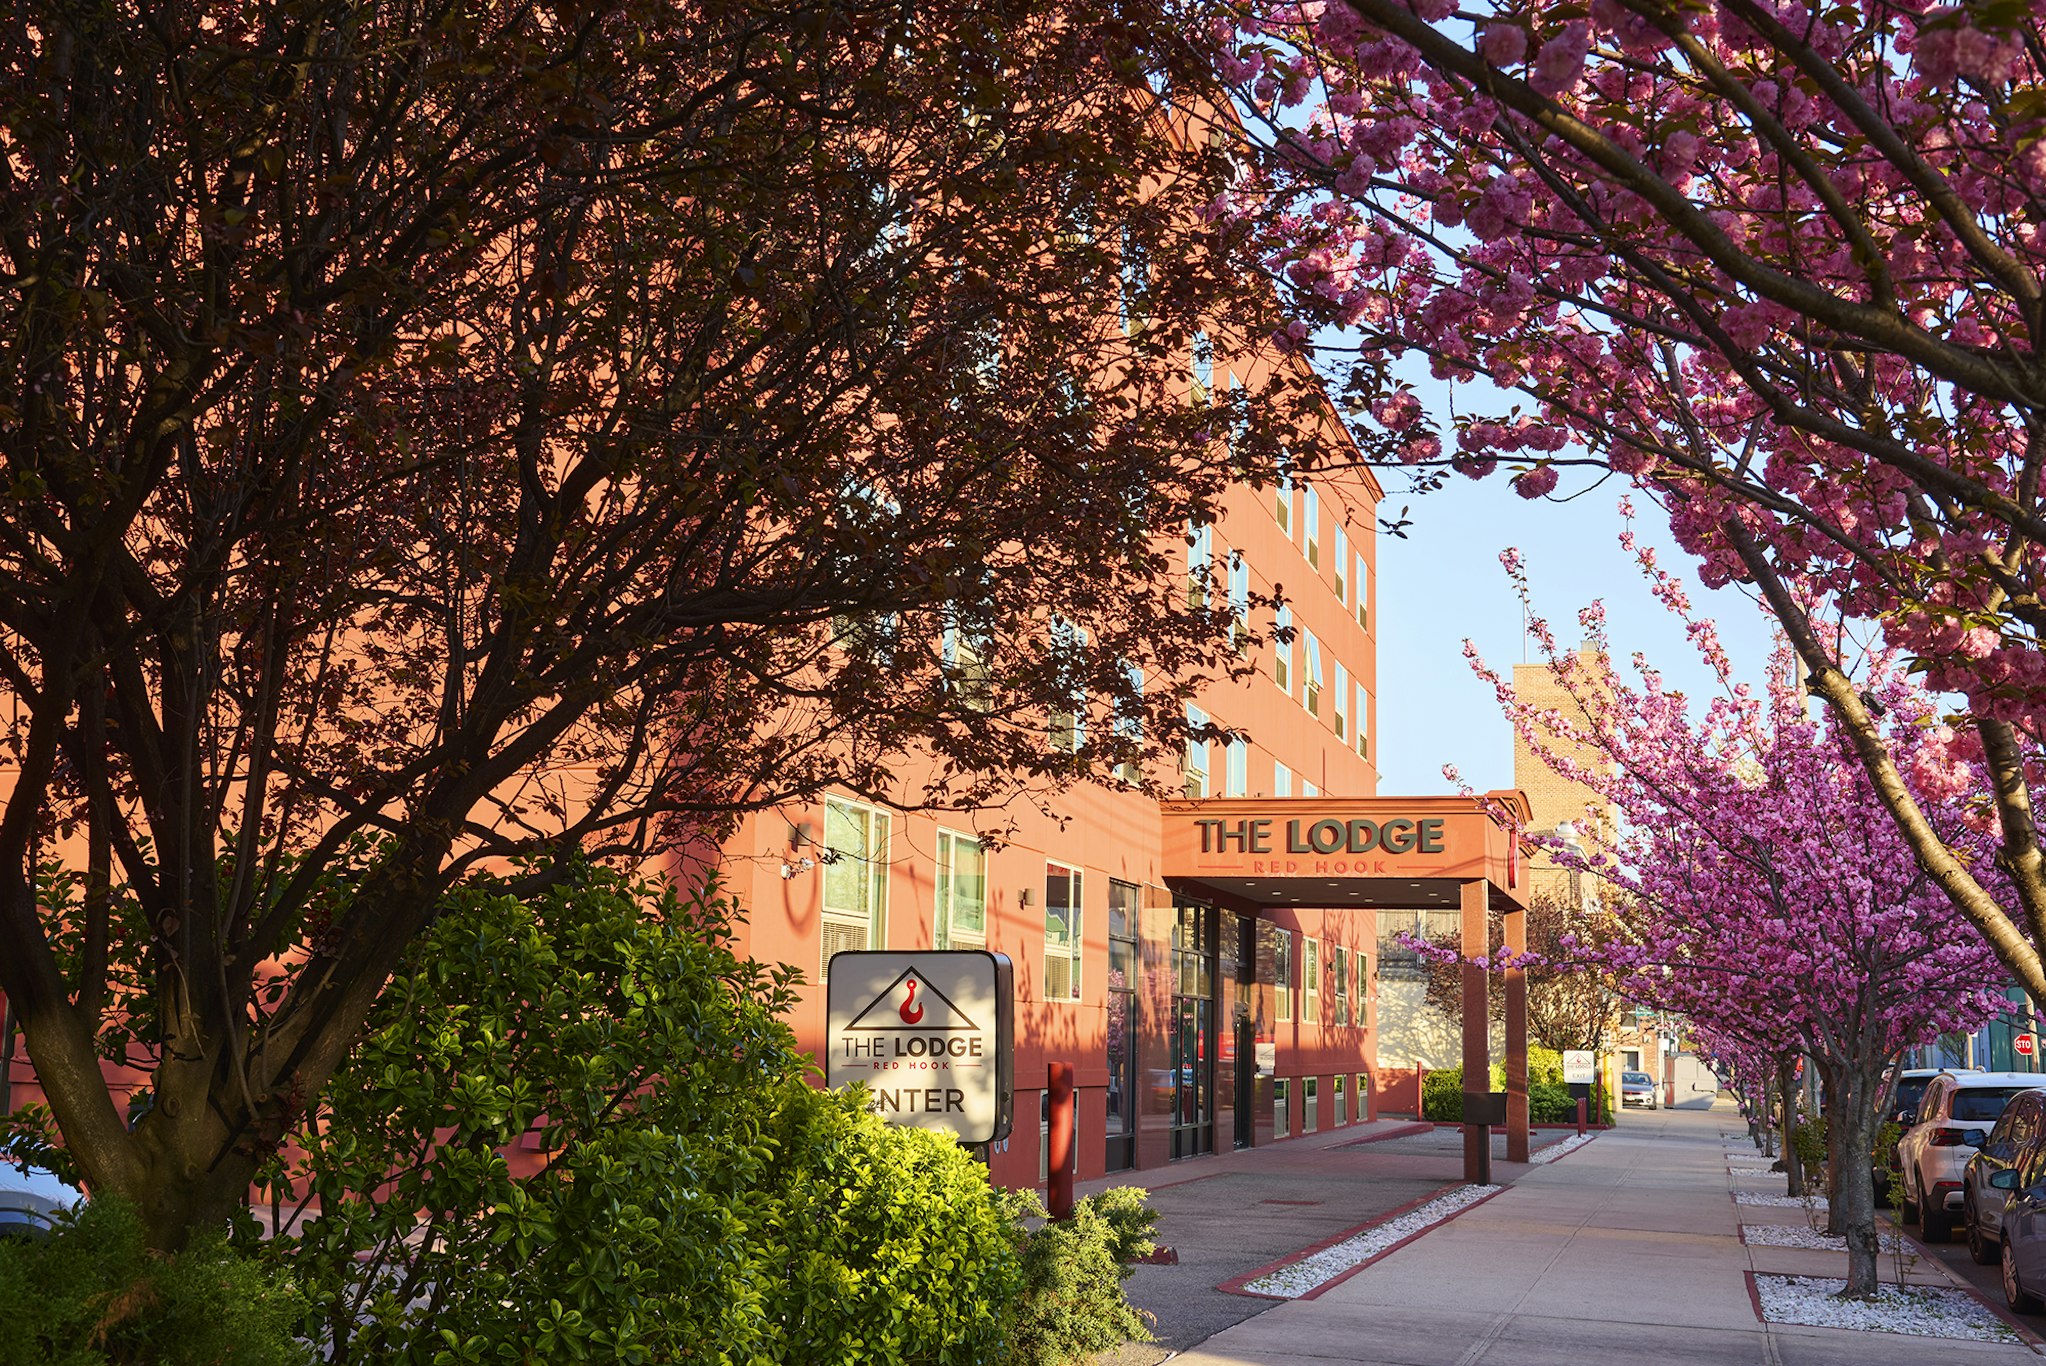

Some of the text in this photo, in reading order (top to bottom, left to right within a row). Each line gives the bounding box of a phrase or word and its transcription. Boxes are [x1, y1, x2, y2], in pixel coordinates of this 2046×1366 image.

[1195, 818, 1446, 855] THE LODGE
[1253, 860, 1387, 874] RED HOOK
[841, 1036, 982, 1058] THE LODGE
[2016, 1040, 2032, 1049] STO
[873, 1061, 950, 1070] RED HOOK
